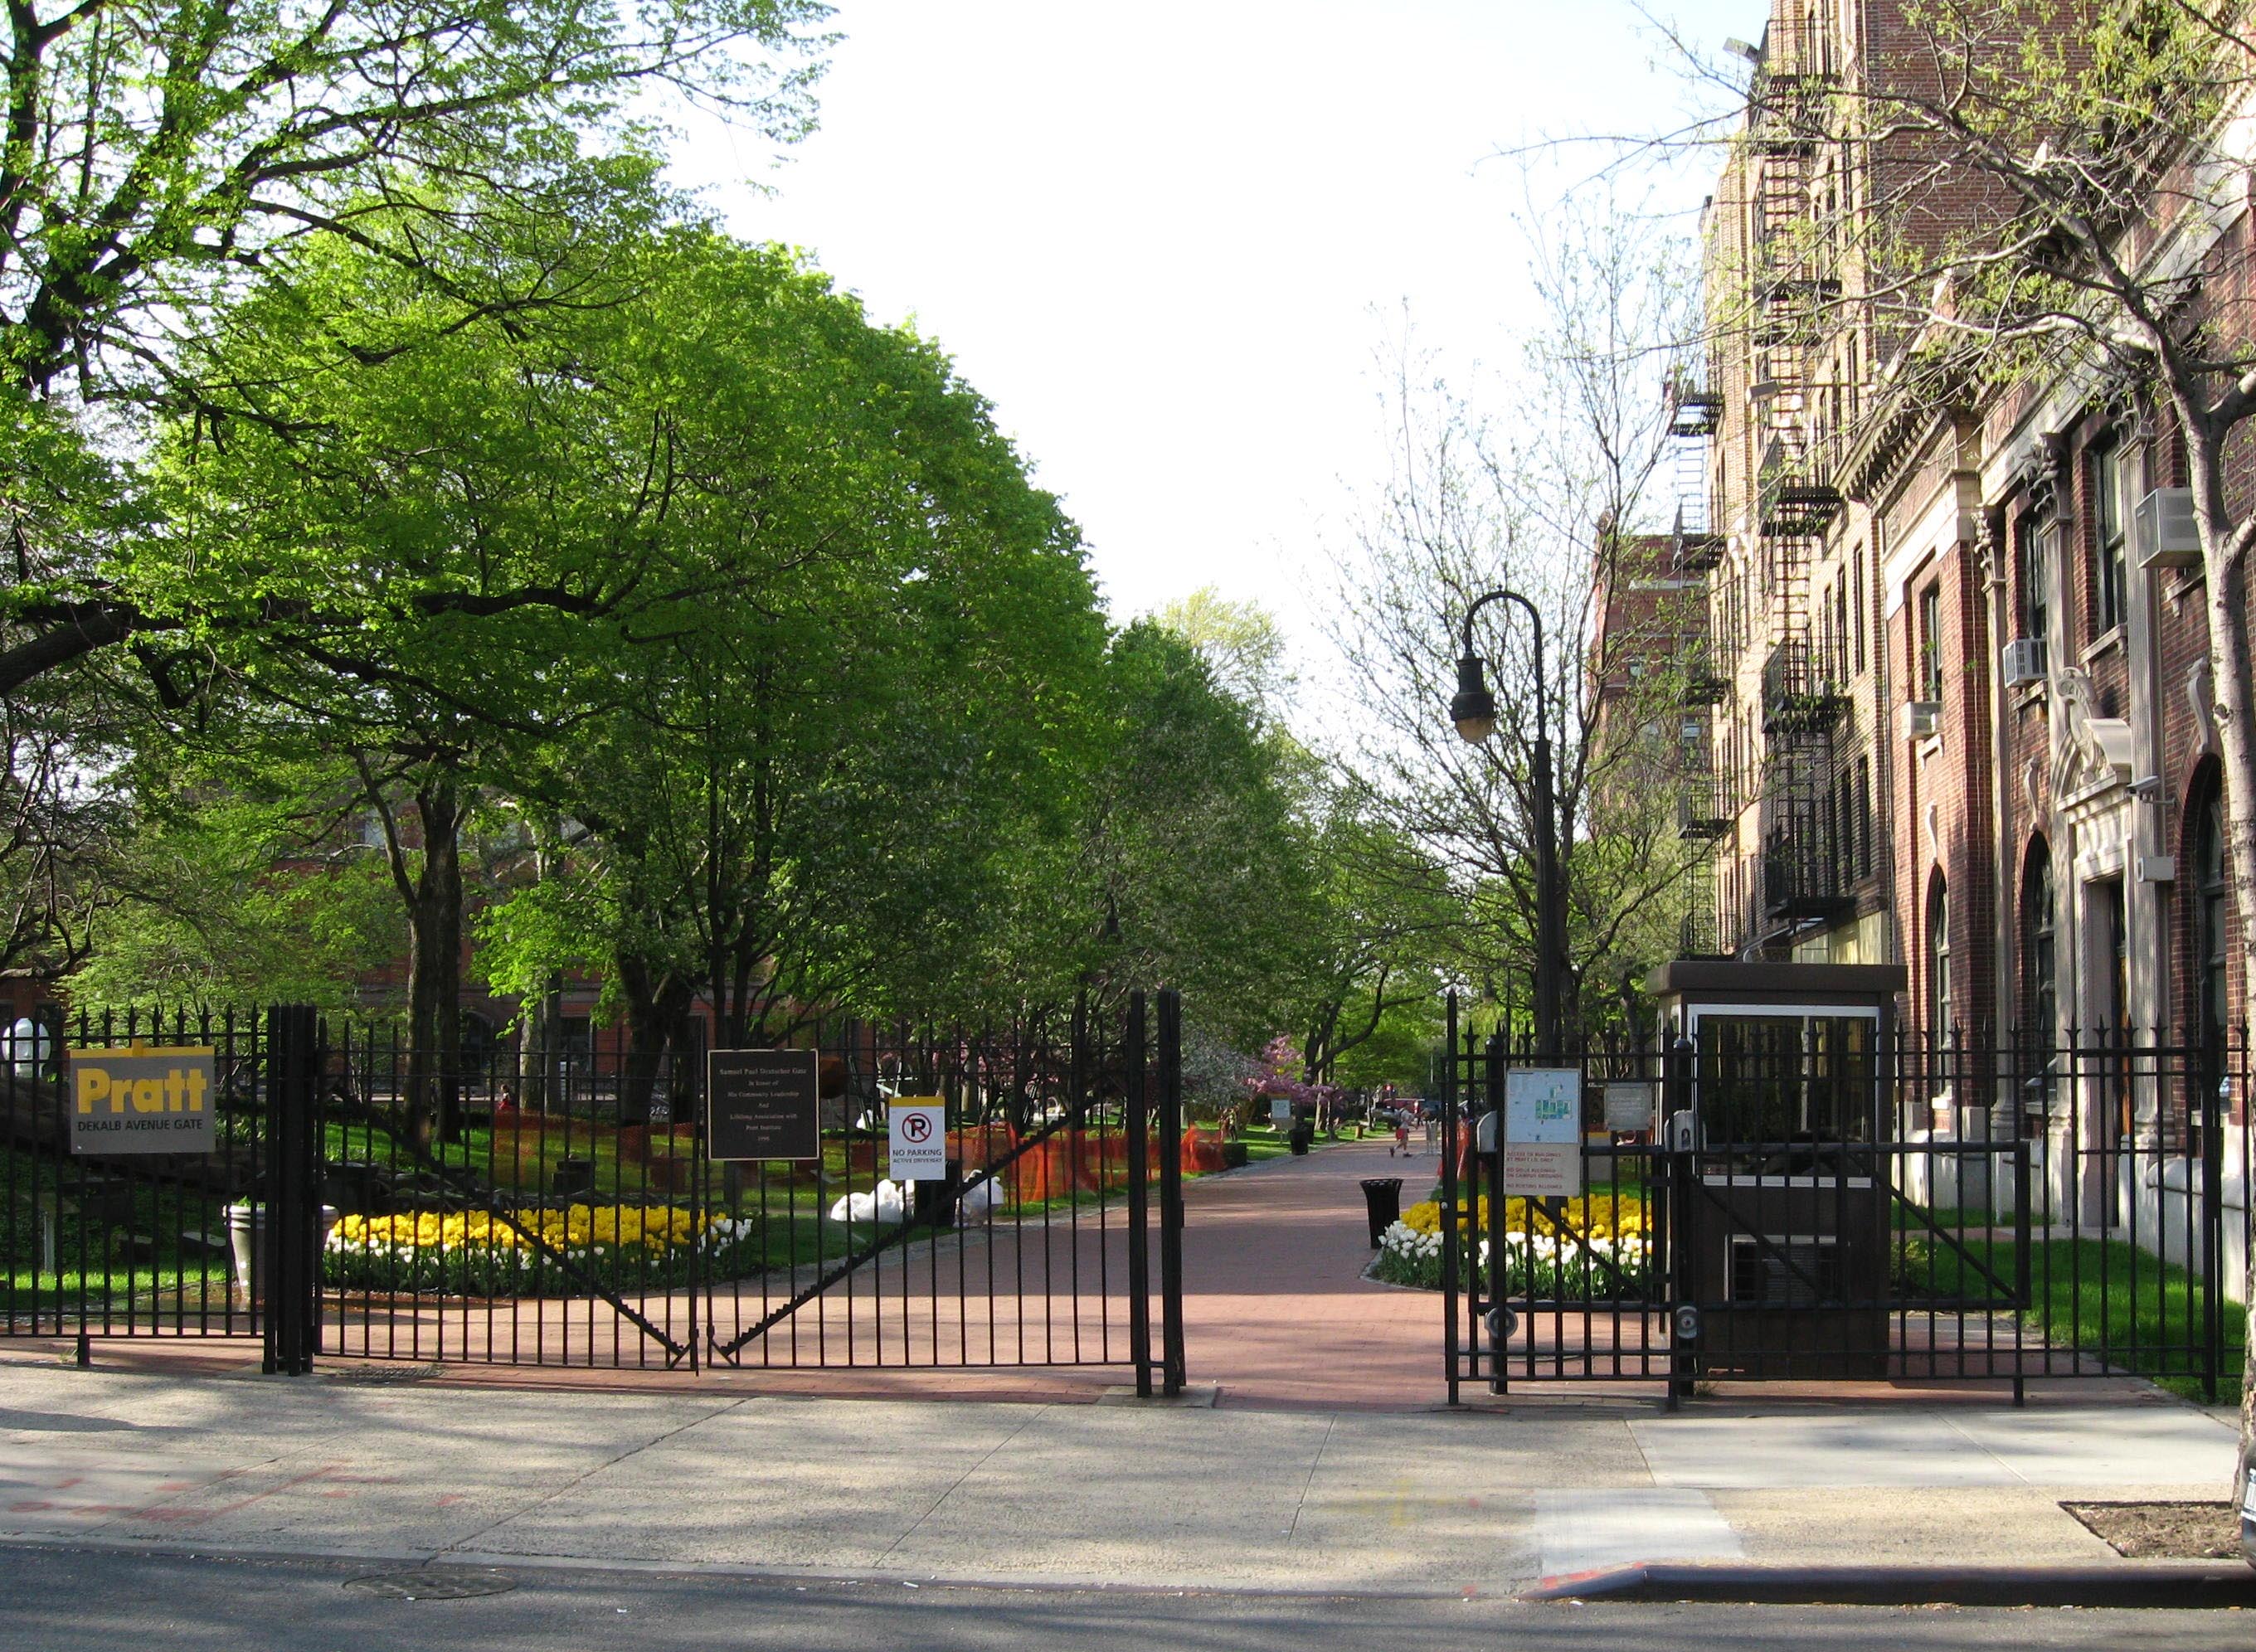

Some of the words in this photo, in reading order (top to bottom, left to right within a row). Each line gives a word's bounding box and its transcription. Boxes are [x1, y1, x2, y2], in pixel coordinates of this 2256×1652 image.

[77, 1067, 207, 1114] Pratt
[78, 1120, 121, 1131] DEKALB
[125, 1120, 170, 1130] AVENUE
[174, 1120, 202, 1130] GATE
